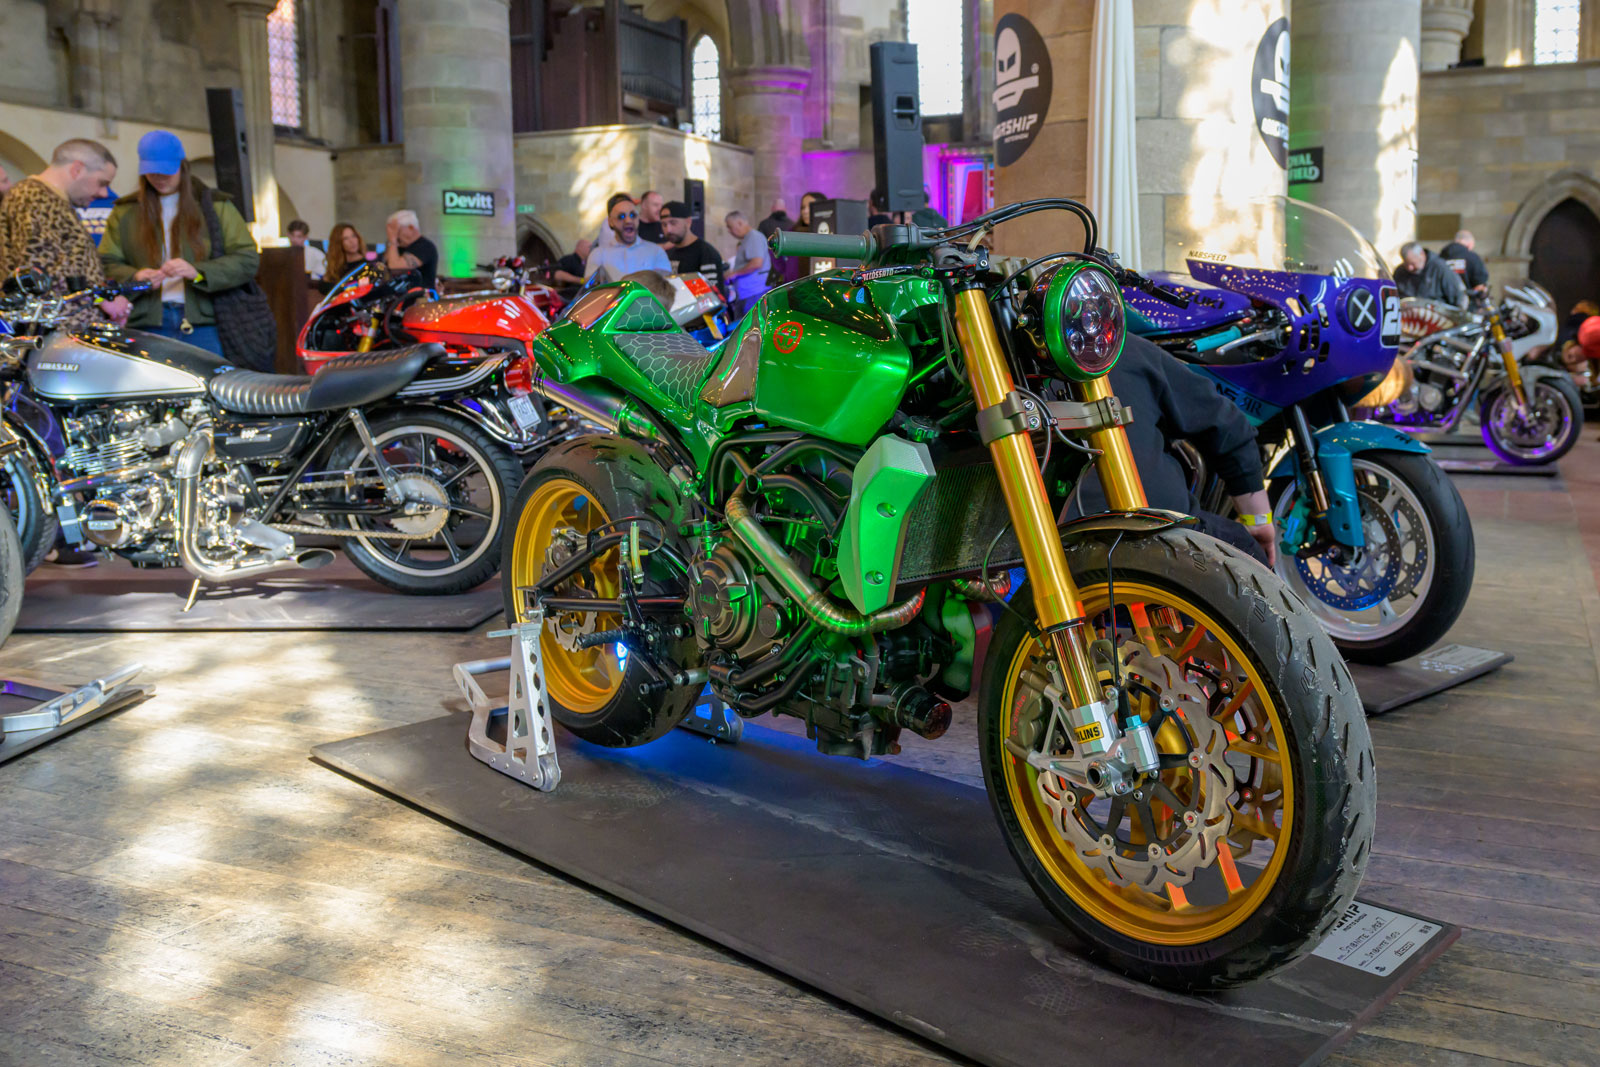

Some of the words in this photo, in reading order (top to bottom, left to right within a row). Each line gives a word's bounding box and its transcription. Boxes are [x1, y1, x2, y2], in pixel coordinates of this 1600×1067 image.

[444, 191, 493, 209] Devitt
[1011, 695, 1027, 737] brembo
[1078, 726, 1100, 741] LINS
